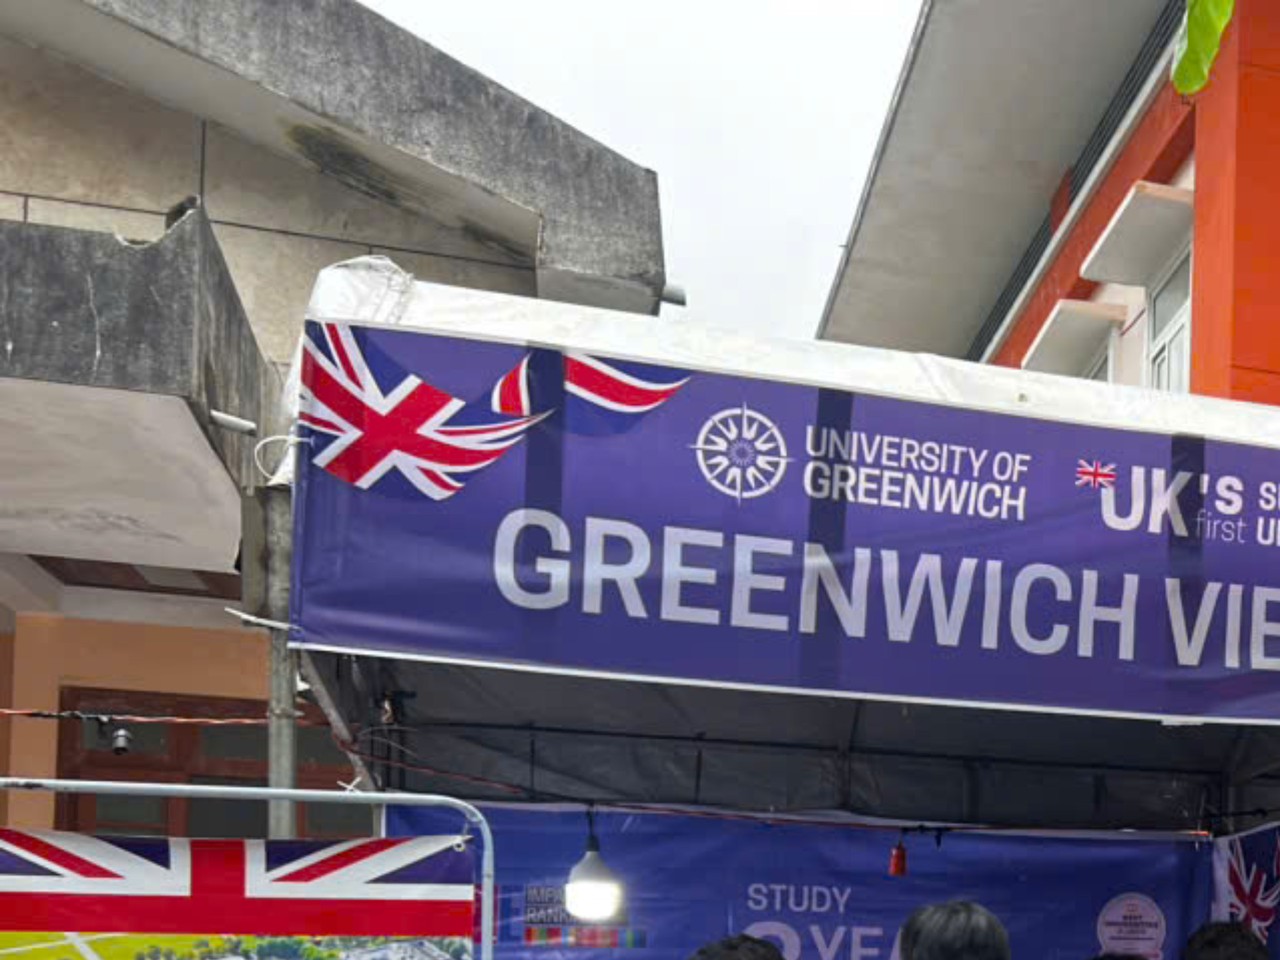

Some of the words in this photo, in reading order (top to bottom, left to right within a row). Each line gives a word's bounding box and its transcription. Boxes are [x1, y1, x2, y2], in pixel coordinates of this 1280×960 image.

[805, 425, 987, 479] UNIVERSITY
[992, 450, 1030, 483] OF
[803, 464, 1027, 521] GREENWICH
[1195, 510, 1246, 544] first
[492, 507, 1139, 661] GREENWICH
[747, 883, 852, 914] STUDY
